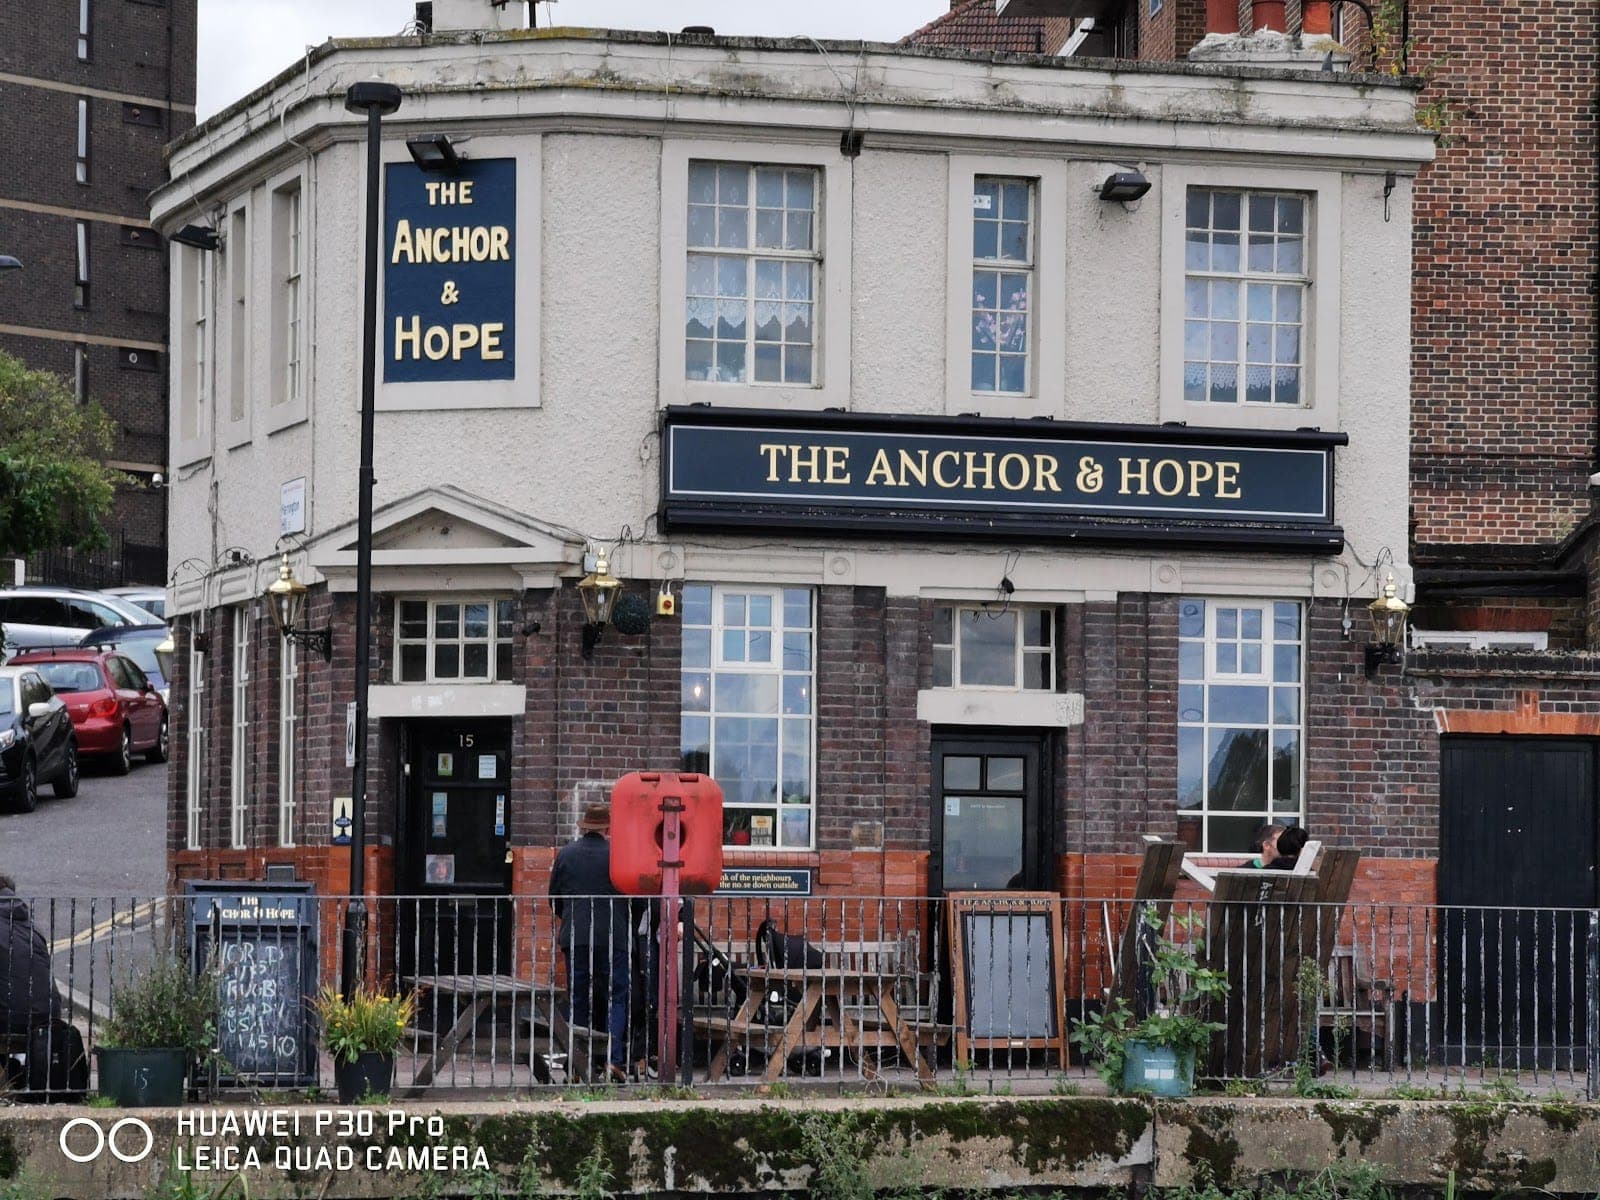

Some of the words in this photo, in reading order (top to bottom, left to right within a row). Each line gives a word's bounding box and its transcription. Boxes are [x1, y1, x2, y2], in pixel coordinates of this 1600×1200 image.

[425, 181, 473, 205] THE
[391, 219, 510, 264] ANCHOR
[440, 280, 460, 305] &
[394, 315, 504, 361] HOPE
[759, 443, 851, 483] THE
[865, 449, 1061, 493] ANCHOR
[1076, 457, 1104, 494] &
[1118, 458, 1242, 500] HOPE
[459, 734, 474, 748] 15
[730, 872, 739, 881] of
[739, 872, 750, 881] the
[752, 873, 792, 883] neighbours
[752, 881, 771, 889] down
[207, 909, 251, 919] ACHOR
[133, 1067, 148, 1090] 15
